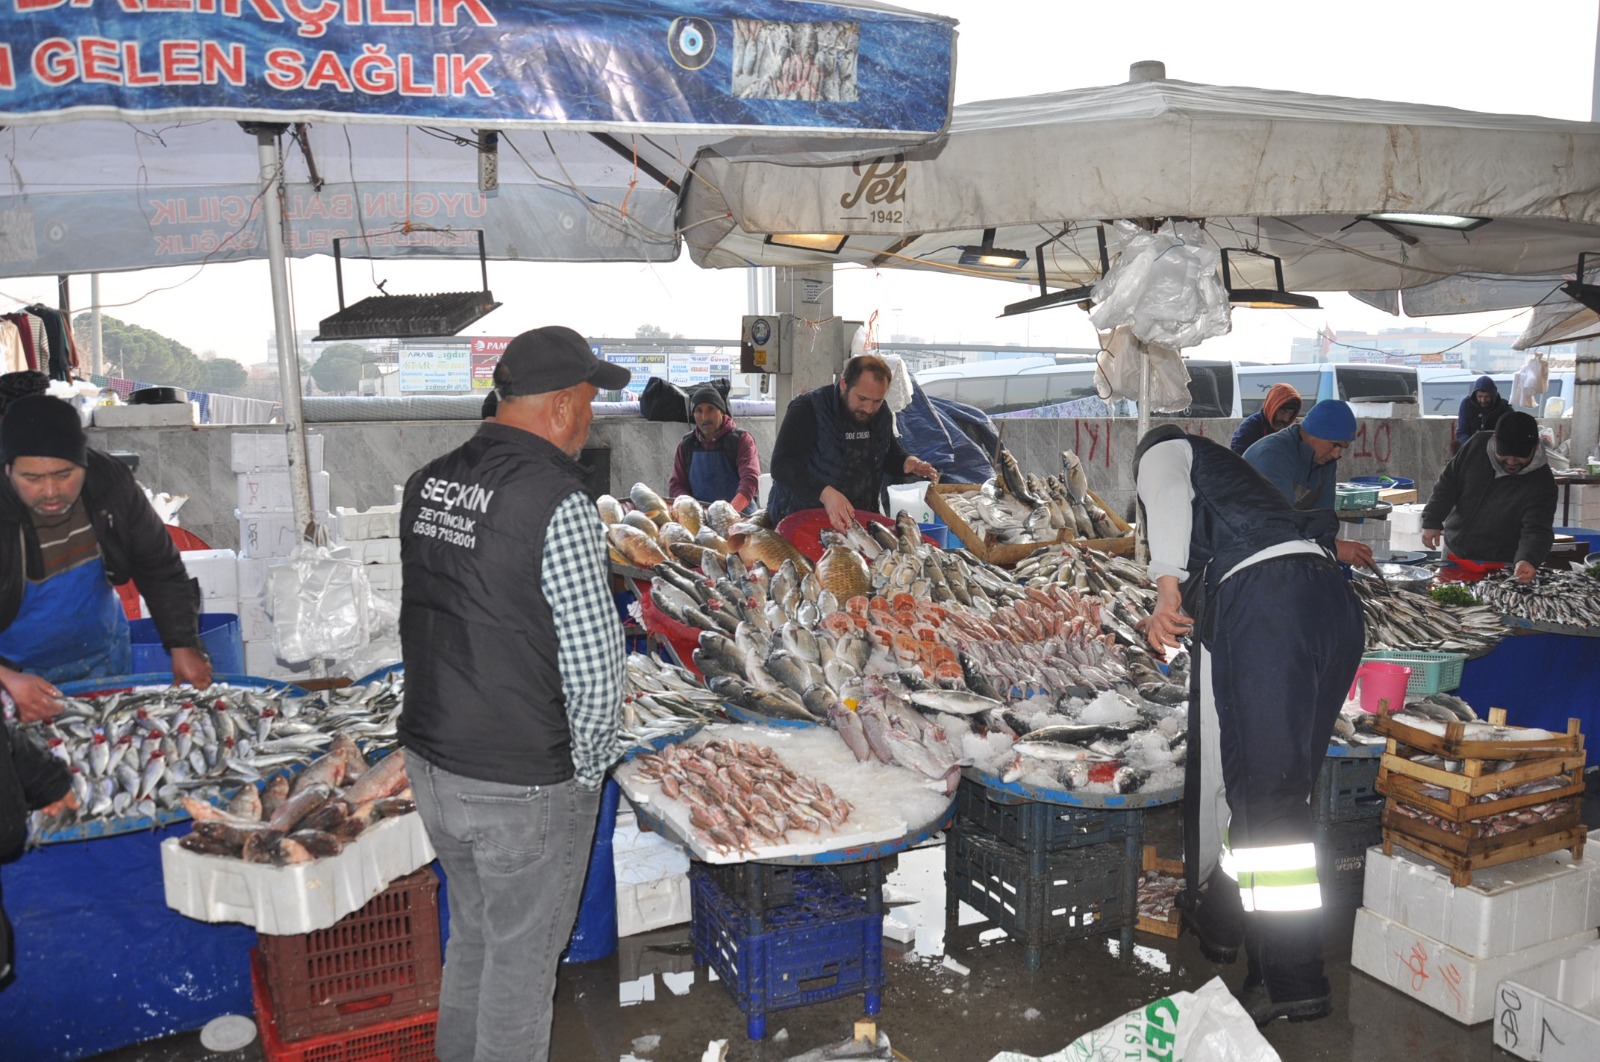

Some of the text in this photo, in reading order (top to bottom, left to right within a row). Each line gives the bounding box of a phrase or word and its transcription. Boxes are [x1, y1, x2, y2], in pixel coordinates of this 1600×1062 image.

[31, 36, 246, 87] GELEN
[265, 44, 495, 97] SAĞLIK
[870, 210, 903, 223] 1942
[1353, 422, 1391, 463] 10
[420, 477, 495, 514] SEÇKİN
[412, 520, 476, 549] 0539 7132001
[417, 506, 477, 533] ZEYTİNCİLİK
